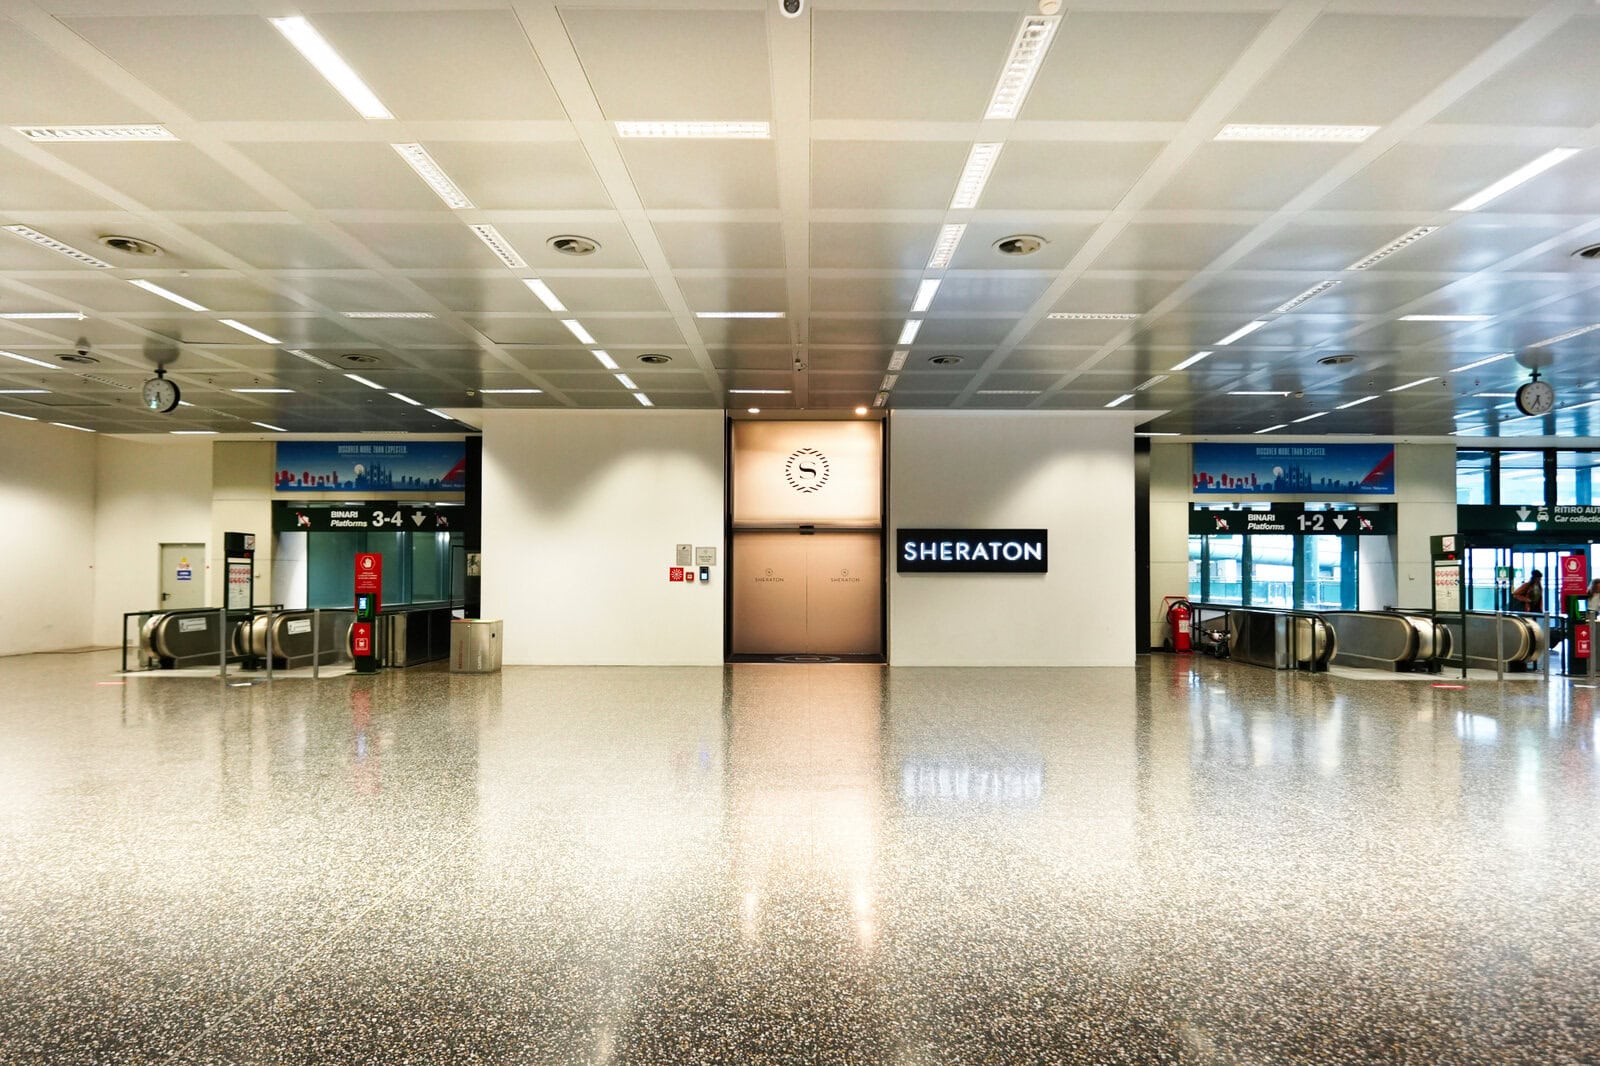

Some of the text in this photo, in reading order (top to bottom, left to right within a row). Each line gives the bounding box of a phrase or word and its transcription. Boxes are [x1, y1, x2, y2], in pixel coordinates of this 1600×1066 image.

[338, 445, 359, 454] DISCOVER
[360, 445, 372, 454] MORE
[373, 445, 384, 454] THAN
[1256, 447, 1277, 456] DISCOVER
[1278, 447, 1290, 456] MORE
[1291, 447, 1303, 456] THAN
[799, 461, 817, 480] S
[330, 510, 359, 518] BINARI
[1554, 506, 1583, 514] RITIRO
[372, 510, 403, 527] 3-4
[1247, 513, 1276, 521] BINARI
[330, 519, 368, 527] Platforms
[1247, 522, 1285, 531] Platforms
[1297, 514, 1325, 531] 1-2
[903, 541, 1042, 561] SHERATON
